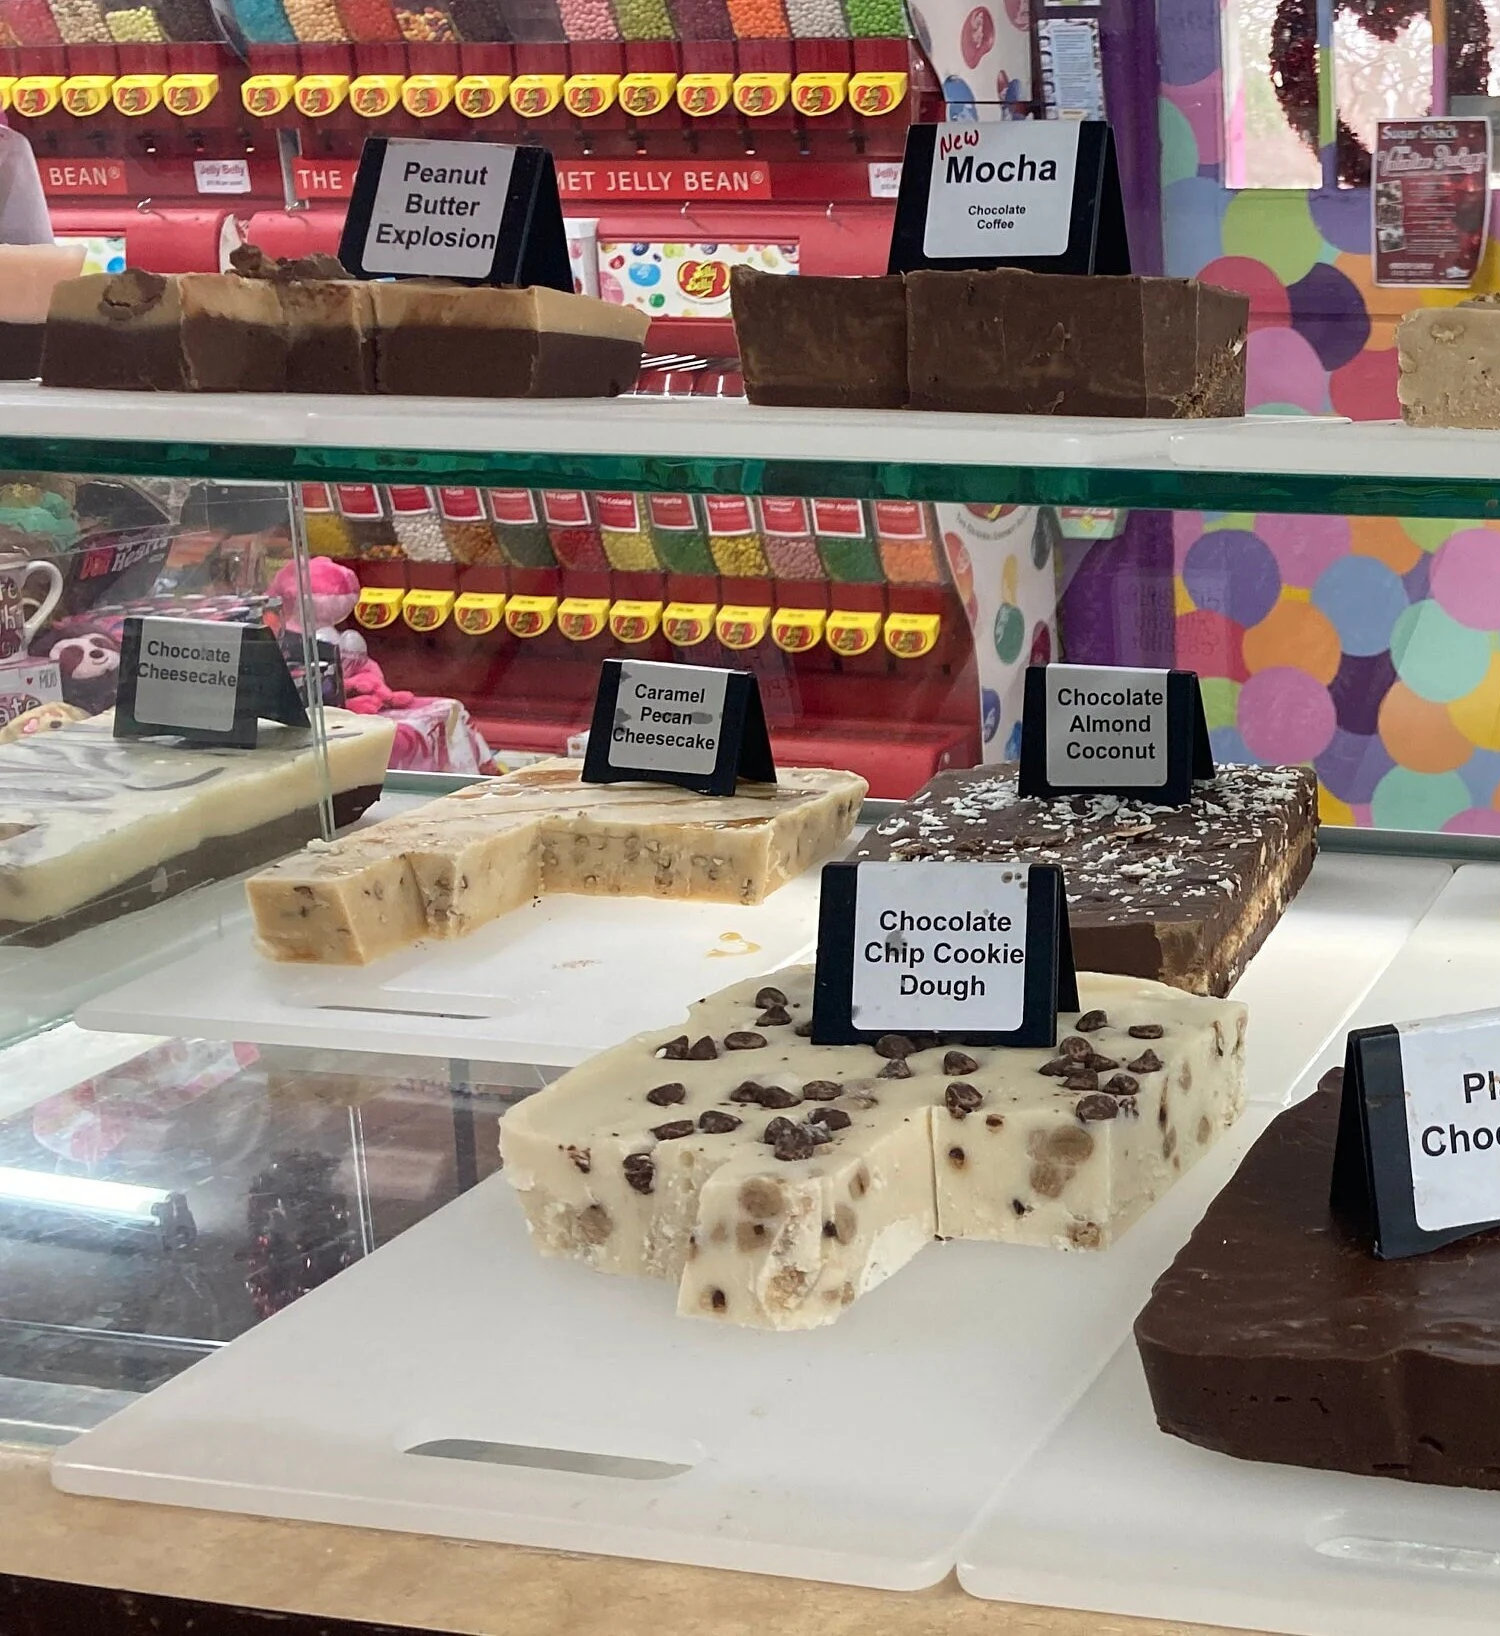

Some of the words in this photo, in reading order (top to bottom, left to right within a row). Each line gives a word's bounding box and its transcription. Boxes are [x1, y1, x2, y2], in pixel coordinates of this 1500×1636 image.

[939, 129, 980, 161] New
[403, 161, 489, 186] Peanut
[946, 153, 1057, 184] Mocha
[300, 169, 343, 191] THE
[606, 171, 672, 192] JELLY
[404, 193, 481, 217] Butter
[968, 204, 1027, 216] Chocolate
[976, 218, 1015, 230] Coffee
[375, 222, 497, 250] Explosion
[137, 662, 237, 688] Cheesecake
[634, 683, 706, 704] Caramel
[1057, 687, 1164, 706] Chocolate
[640, 706, 692, 726] Pecan
[1069, 714, 1151, 733] Almond
[612, 727, 716, 750] Cheesecake
[1066, 741, 1156, 760] Coconut
[879, 909, 1012, 932] Chocolate
[864, 941, 925, 969] Chip
[933, 942, 1025, 964] Cookie
[900, 974, 986, 1001] Dough
